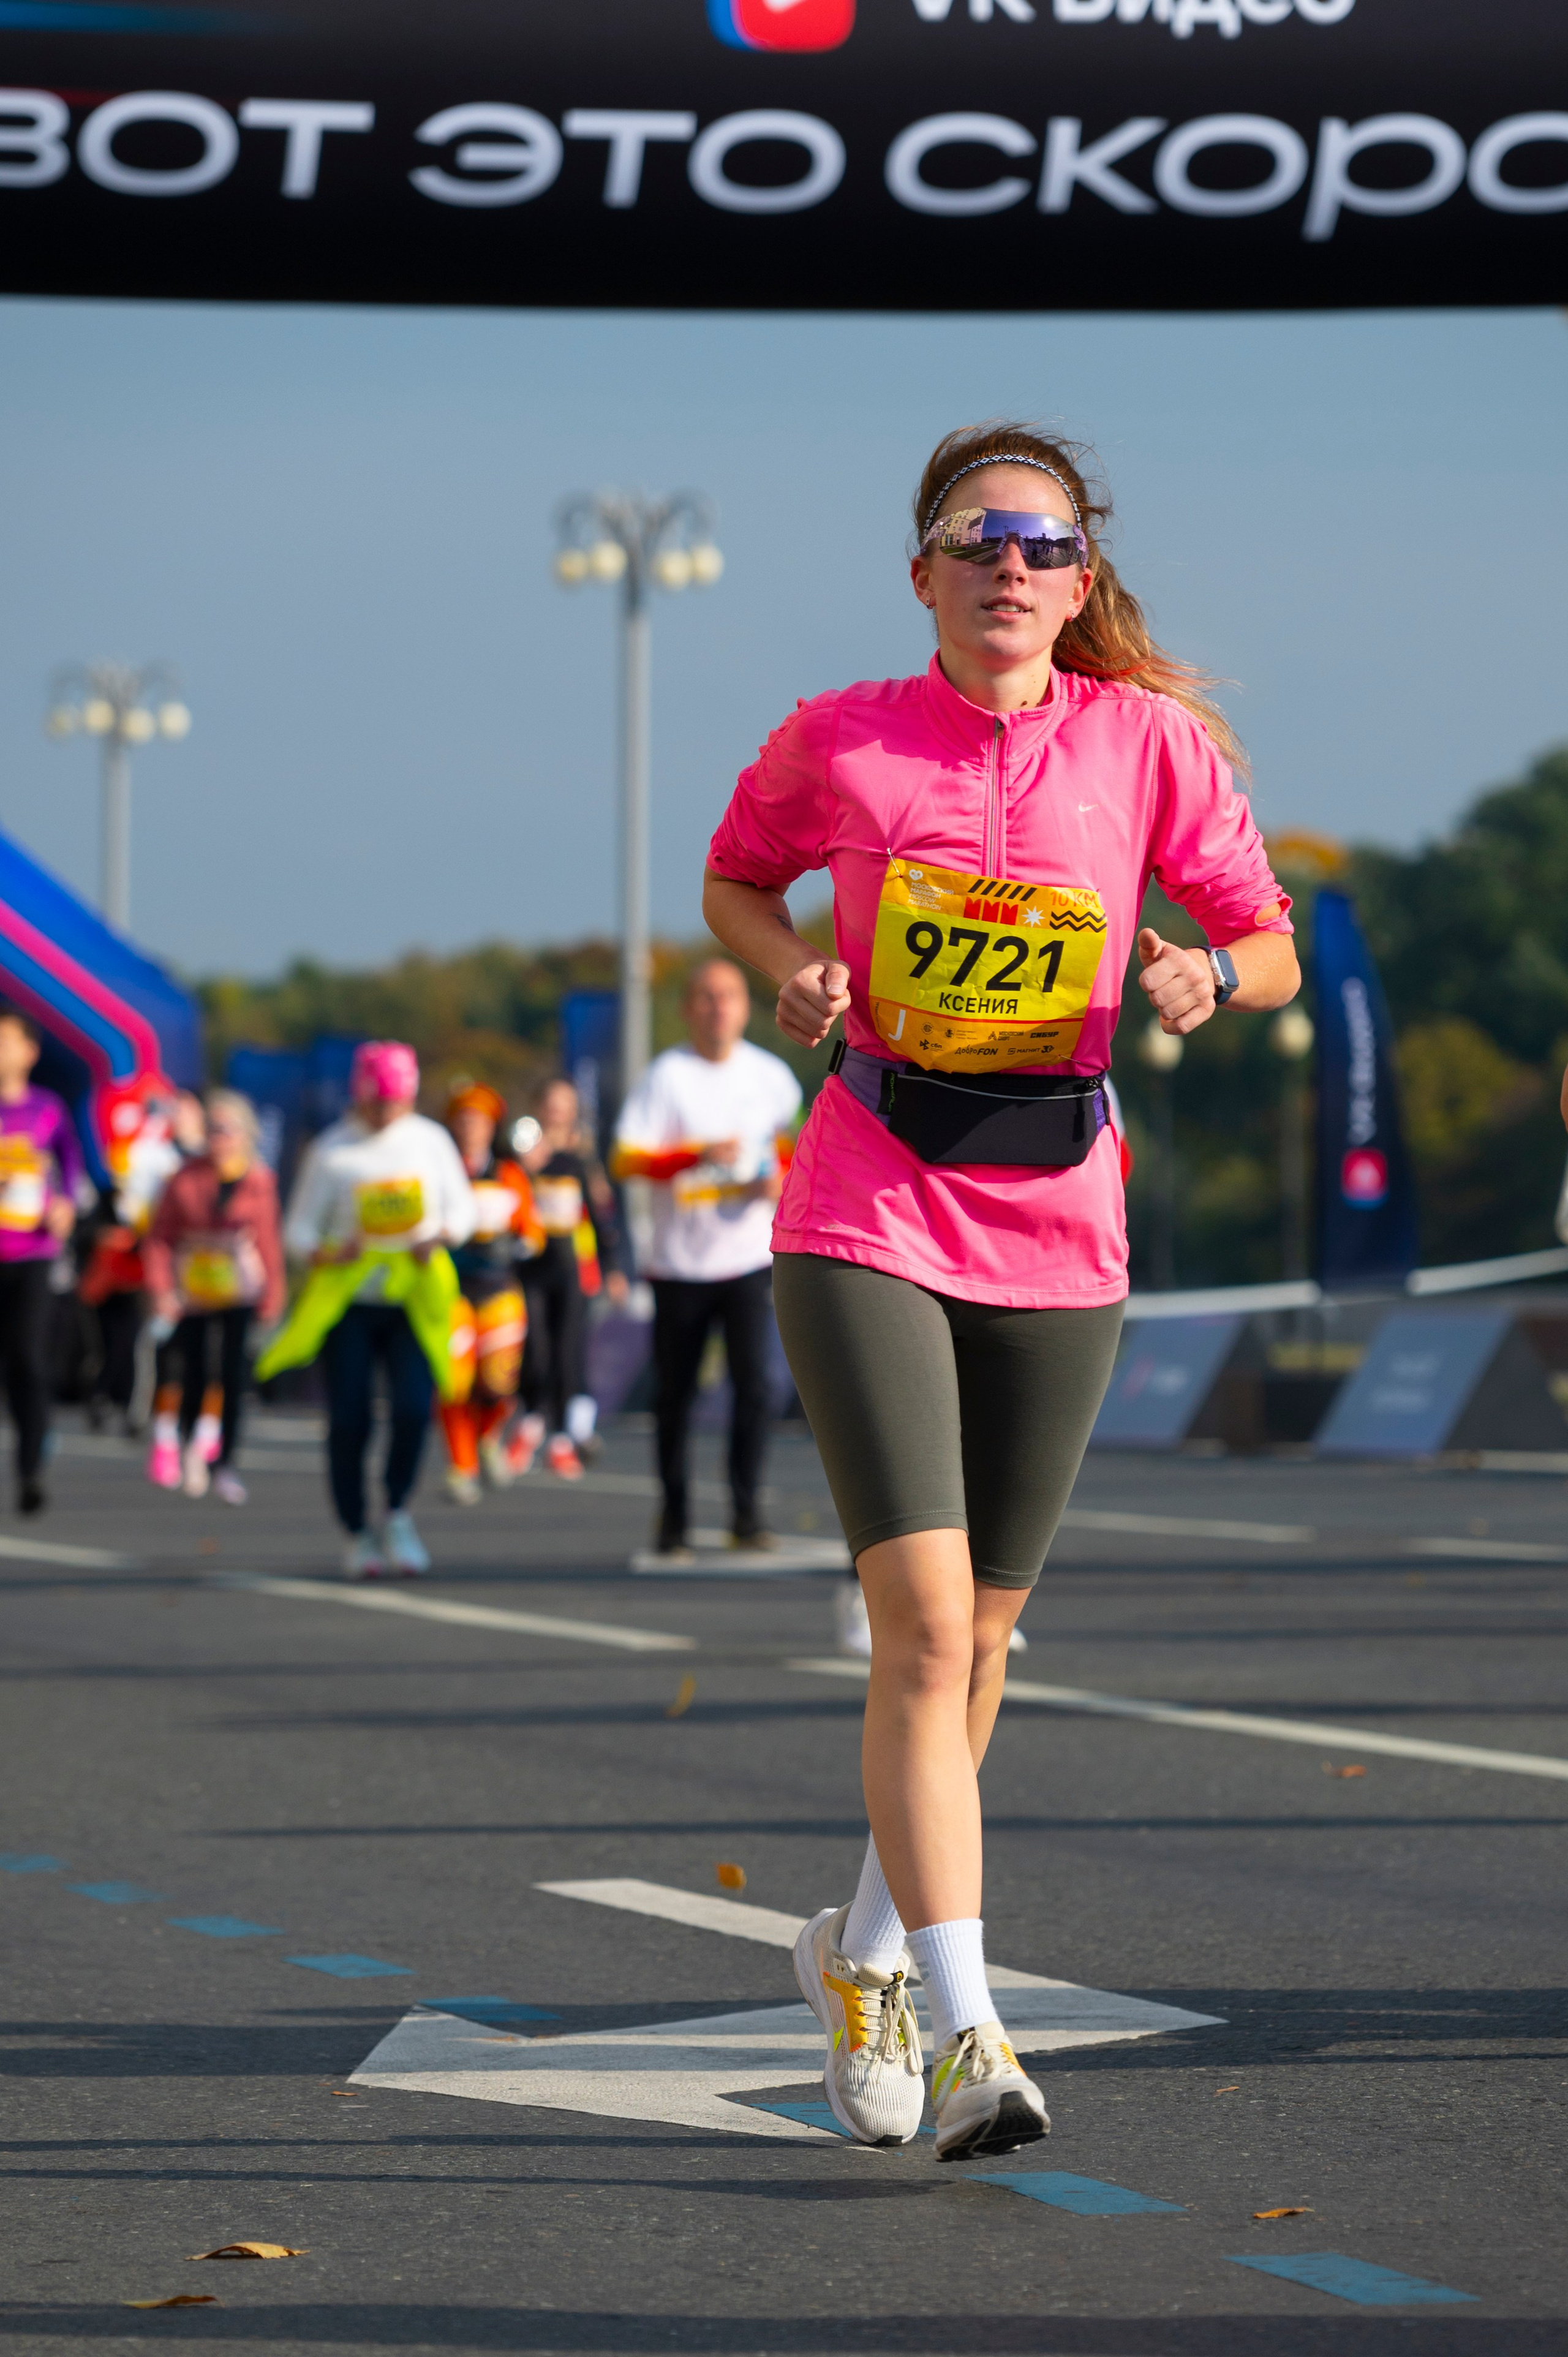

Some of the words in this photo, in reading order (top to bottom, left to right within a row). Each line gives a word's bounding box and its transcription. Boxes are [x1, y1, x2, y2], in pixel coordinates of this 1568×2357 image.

[911, 888, 941, 899] МАРАФОН
[1050, 891, 1069, 906] 10
[908, 899, 941, 910] MARATHON
[905, 921, 1065, 993] 9721
[939, 992, 1019, 1014] КСЕНИЯ
[888, 1009, 906, 1041] J
